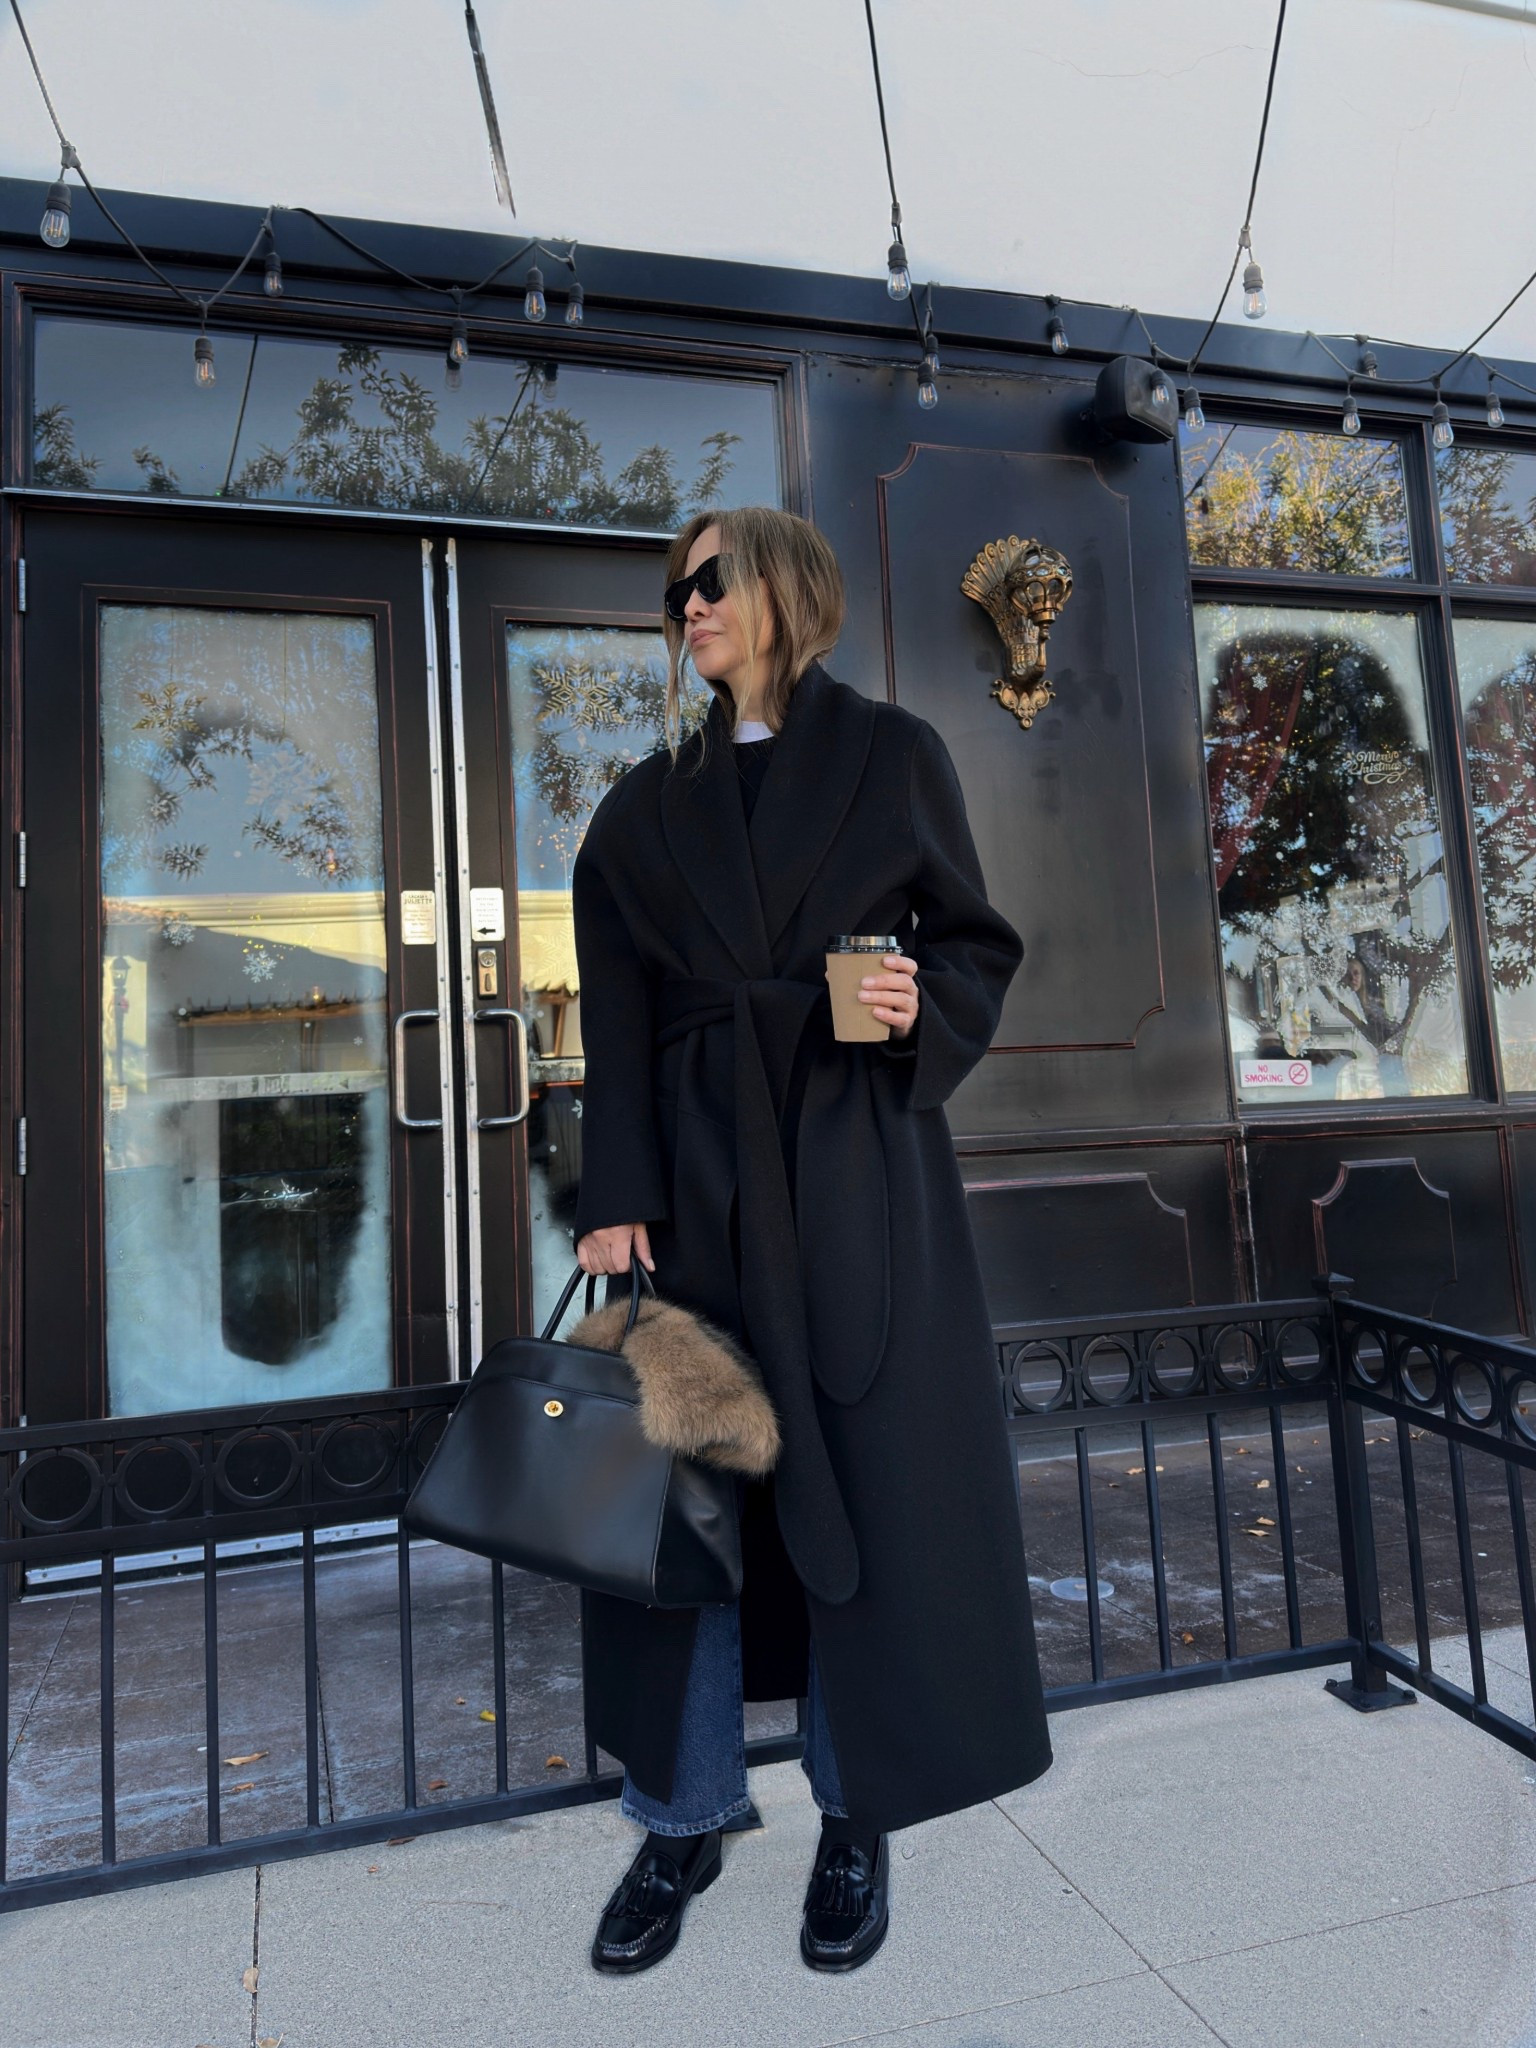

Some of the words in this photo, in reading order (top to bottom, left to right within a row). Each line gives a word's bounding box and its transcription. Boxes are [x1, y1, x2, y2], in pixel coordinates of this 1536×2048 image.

[1356, 751, 1399, 763] Merry
[1346, 761, 1407, 782] Christmas
[1258, 1065, 1268, 1073] NO
[1244, 1075, 1283, 1083] SMOKING
